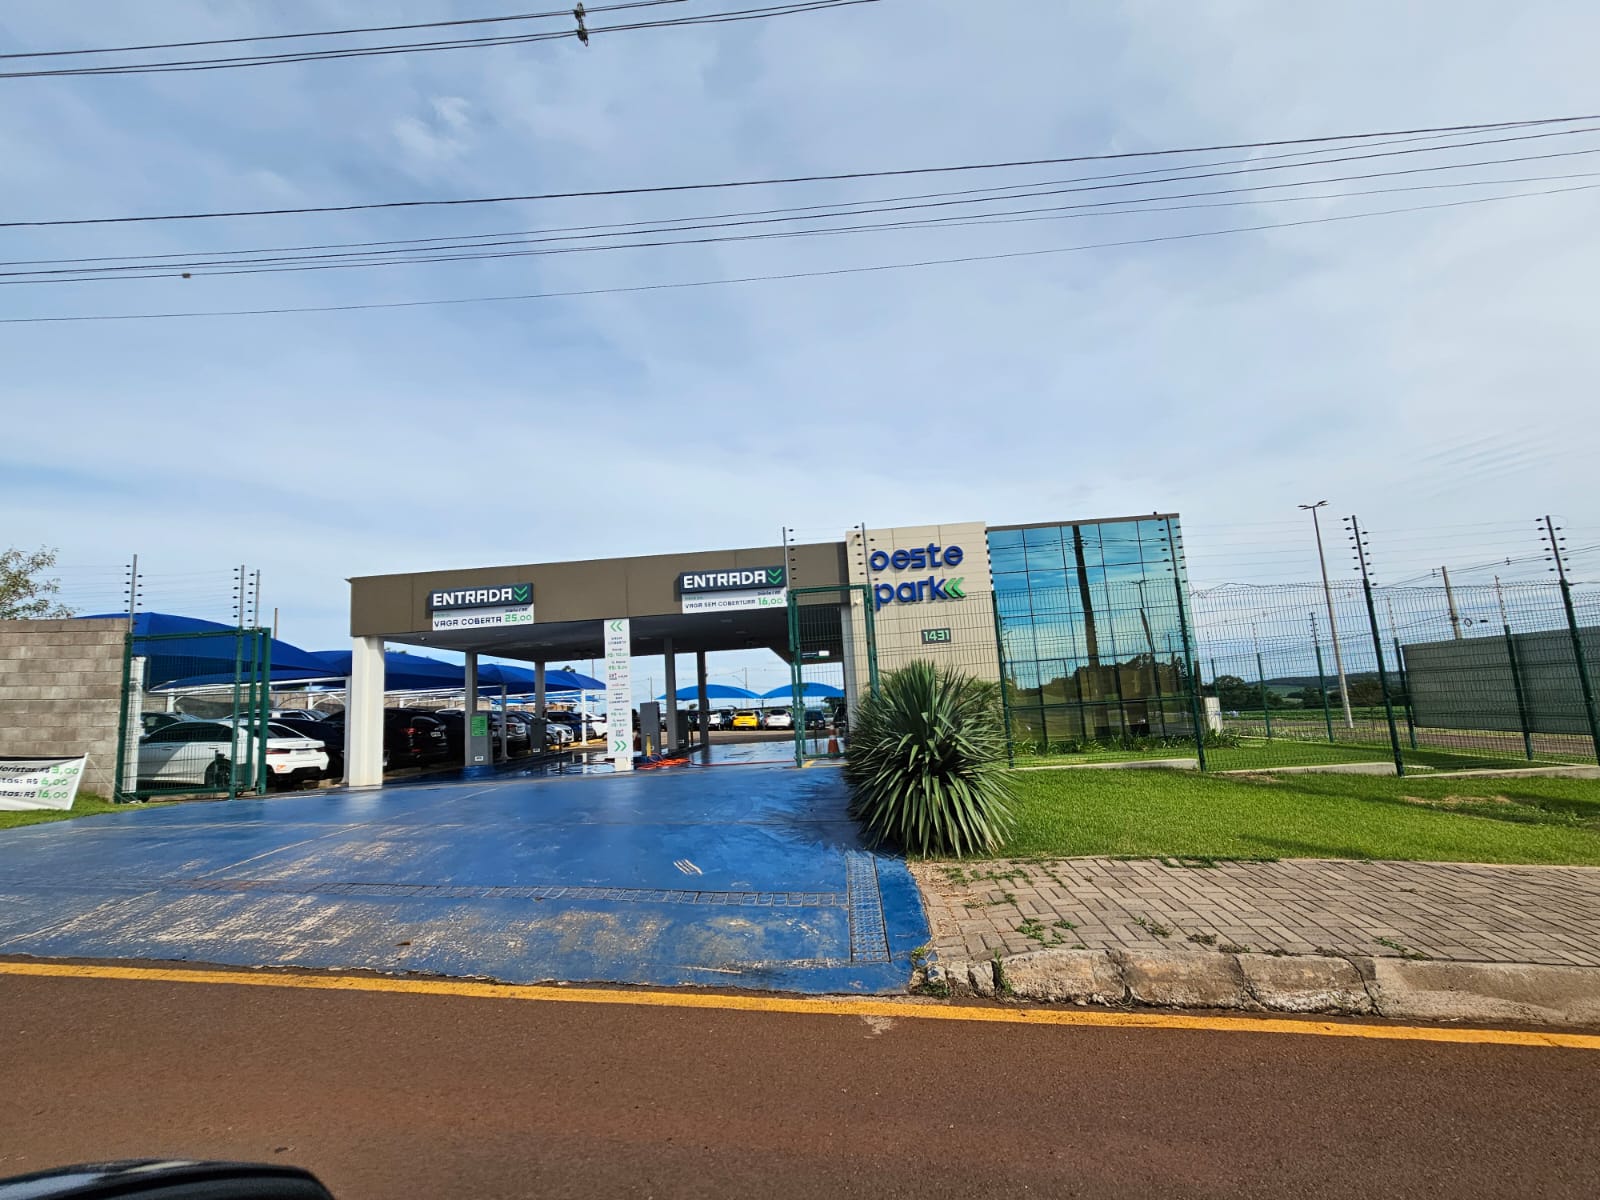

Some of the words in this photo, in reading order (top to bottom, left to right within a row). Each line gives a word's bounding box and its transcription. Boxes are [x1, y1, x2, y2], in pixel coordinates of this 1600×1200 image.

[870, 543, 963, 571] oeste
[683, 570, 766, 589] ENTRADA
[433, 588, 513, 606] ENTRADA
[874, 576, 948, 611] park
[718, 599, 756, 607] COBERTURA
[757, 597, 784, 606] 16,00
[434, 619, 459, 628] VAGA
[461, 616, 502, 625] COBERTA
[505, 613, 532, 623] 25,00
[923, 630, 950, 641] 1431
[0, 777, 23, 785] tas:
[38, 789, 69, 799] 16,00
